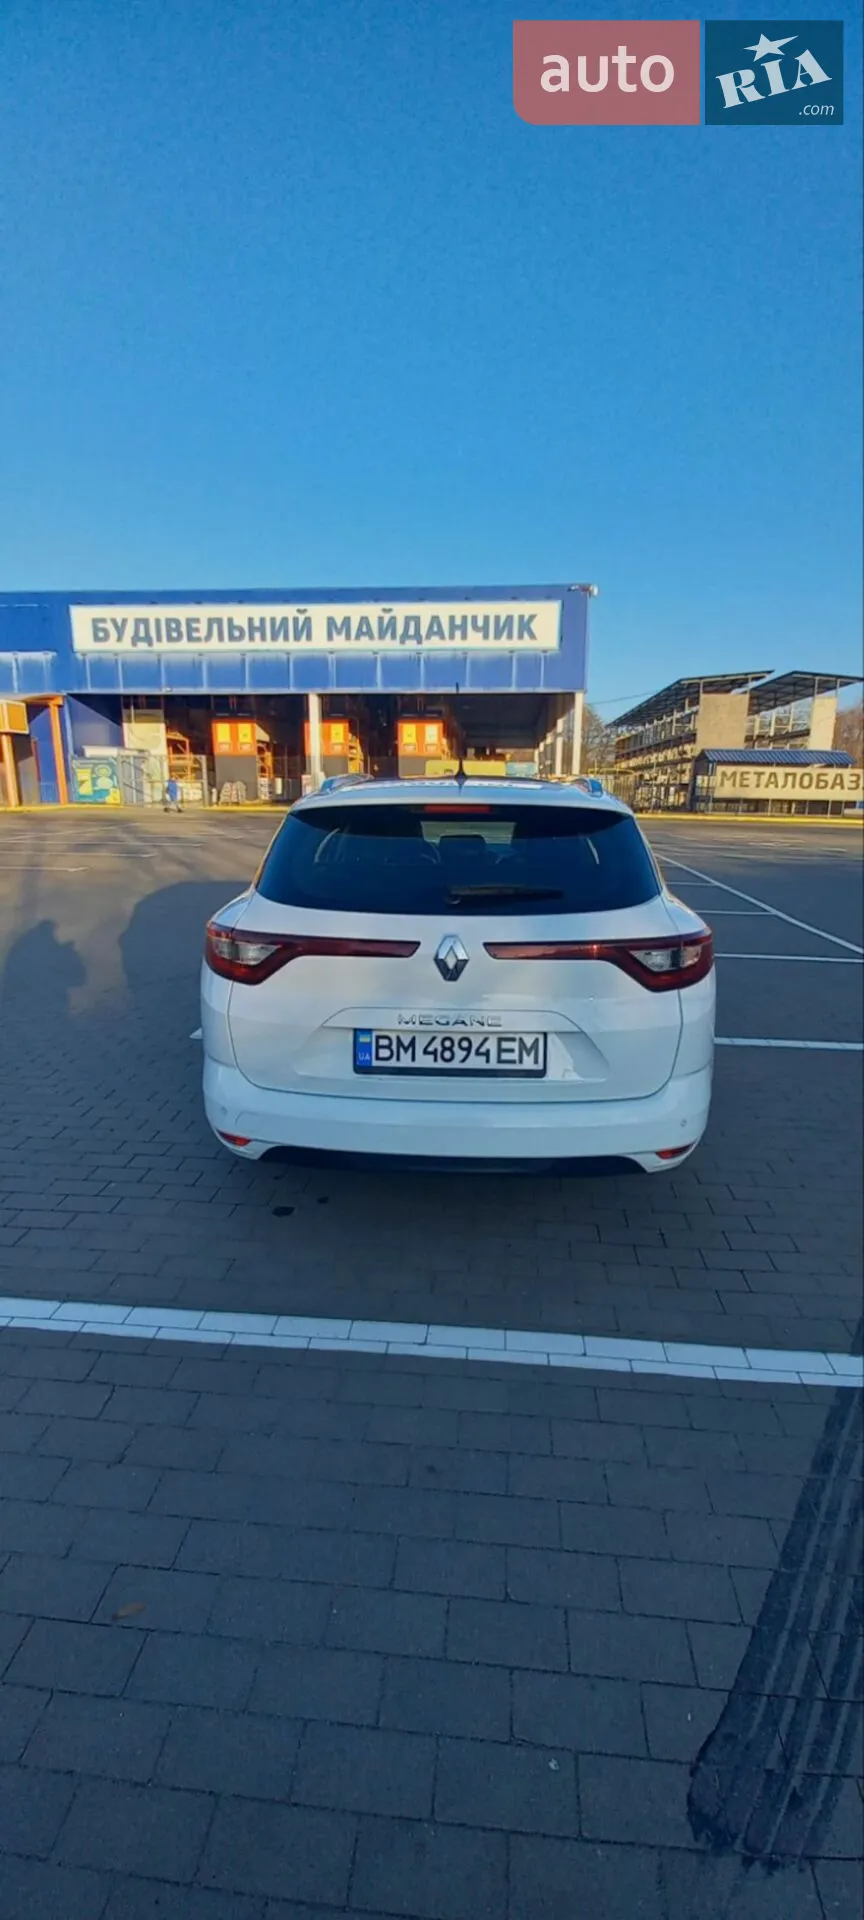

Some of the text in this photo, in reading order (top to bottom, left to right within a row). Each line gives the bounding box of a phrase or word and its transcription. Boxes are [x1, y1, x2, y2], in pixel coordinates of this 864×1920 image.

[91, 607, 537, 647] БУДІВЕЛЬНИЙ МАЙДАНЧИК
[719, 770, 864, 791] МЕТАЛОБАЗ
[398, 1014, 502, 1027] MEGANE
[358, 1053, 371, 1061] UA
[374, 1035, 539, 1064] BM 4894 EM
